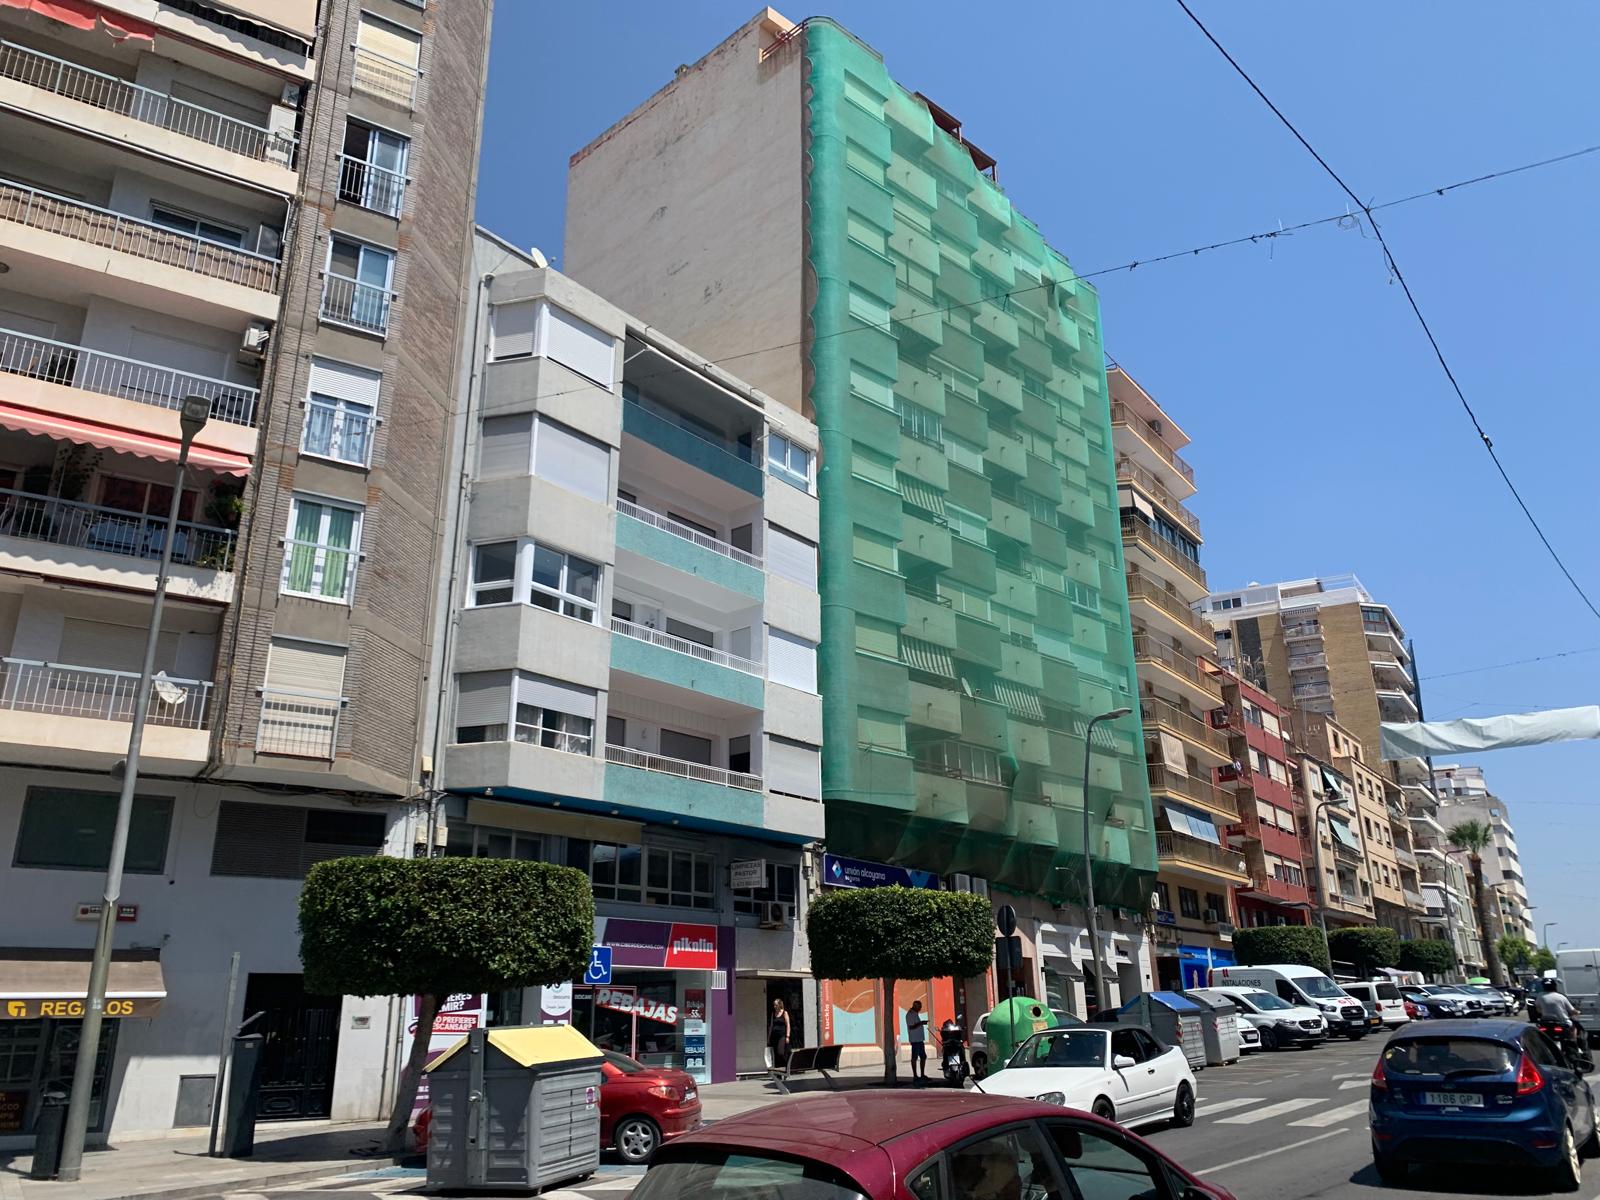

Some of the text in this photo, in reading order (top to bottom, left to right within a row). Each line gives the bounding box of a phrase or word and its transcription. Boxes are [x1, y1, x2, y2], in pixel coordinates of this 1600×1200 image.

[844, 866, 886, 881] unión alcoyana
[673, 937, 714, 955] pikolin
[1222, 979, 1262, 987] INSTALACIONES
[40, 1001, 134, 1016] REGOS
[596, 989, 678, 1023] REBAJAS
[432, 1022, 472, 1031] ESCANSAR?
[443, 1016, 477, 1025] PREFIERES
[1459, 1095, 1481, 1105] GPJ
